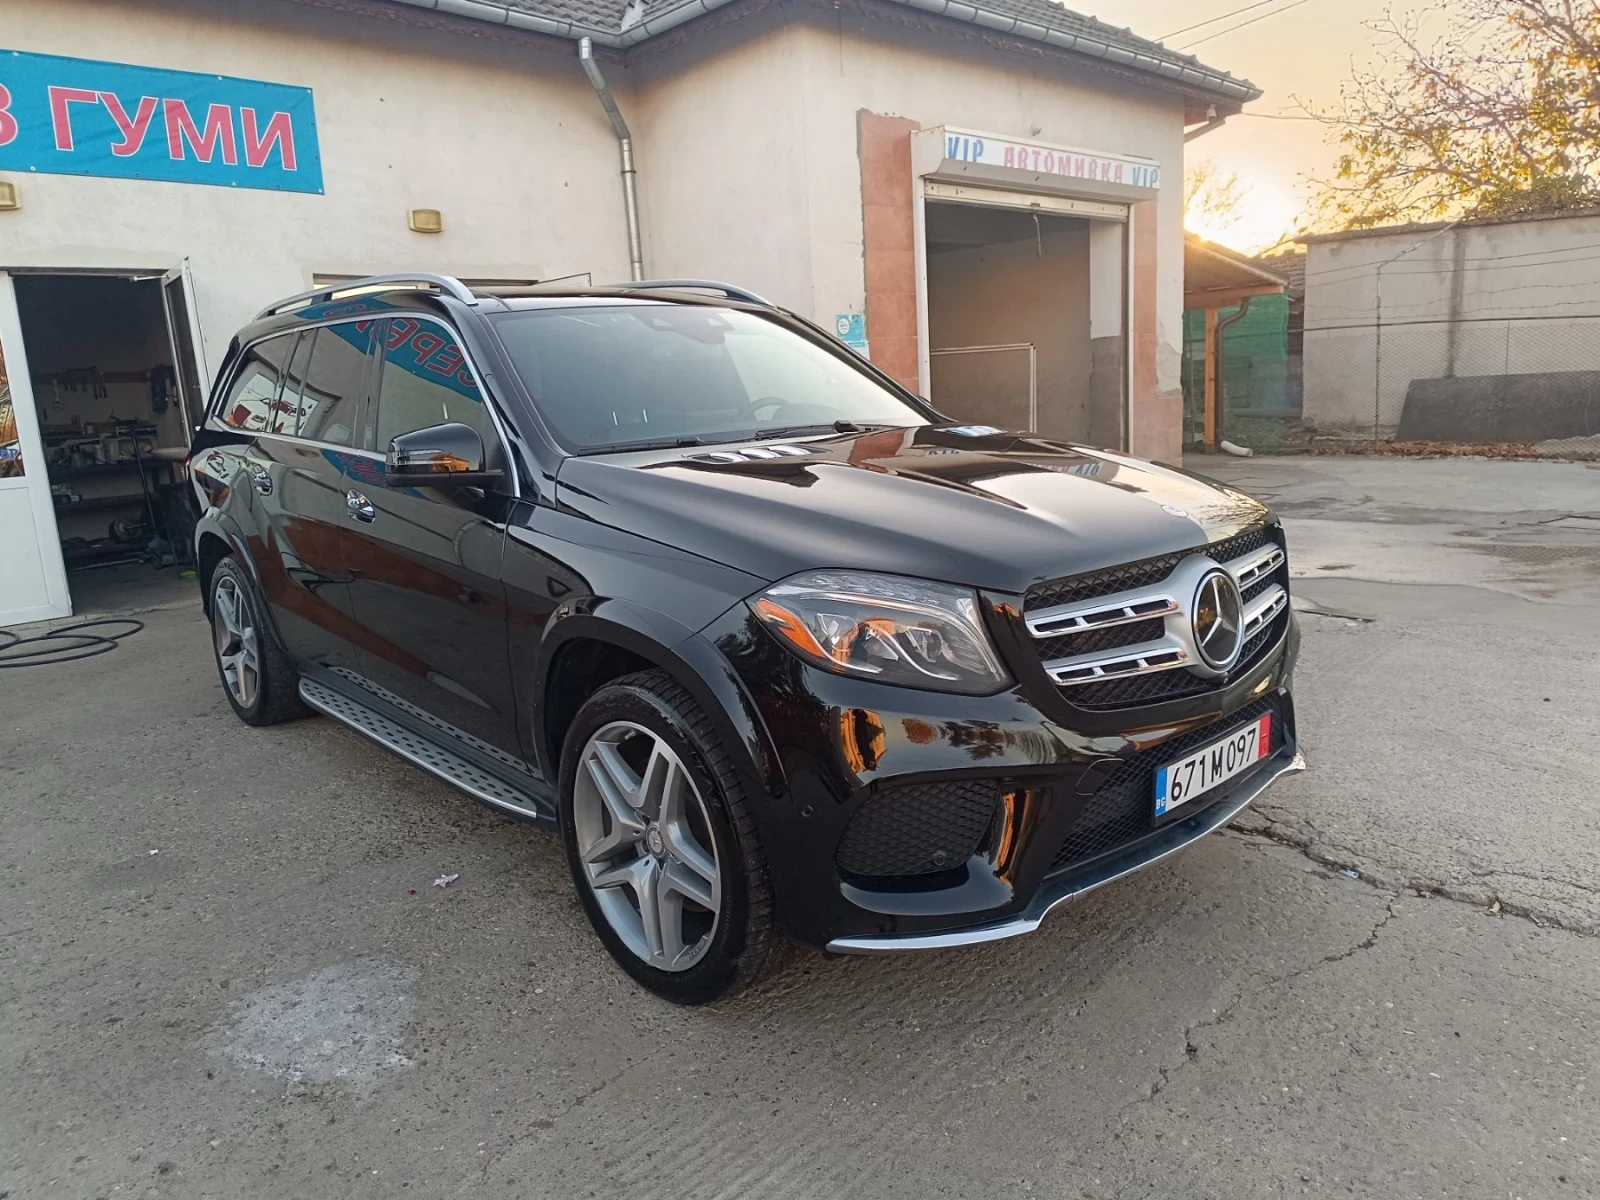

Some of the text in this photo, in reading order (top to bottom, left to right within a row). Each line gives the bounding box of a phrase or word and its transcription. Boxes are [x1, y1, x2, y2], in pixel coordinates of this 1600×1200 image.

[48, 85, 297, 171] ГУМИ
[947, 136, 1159, 188] VIP АВТОМИВКА VIP
[1170, 727, 1256, 802] 671M097
[1156, 797, 1166, 810] BG
